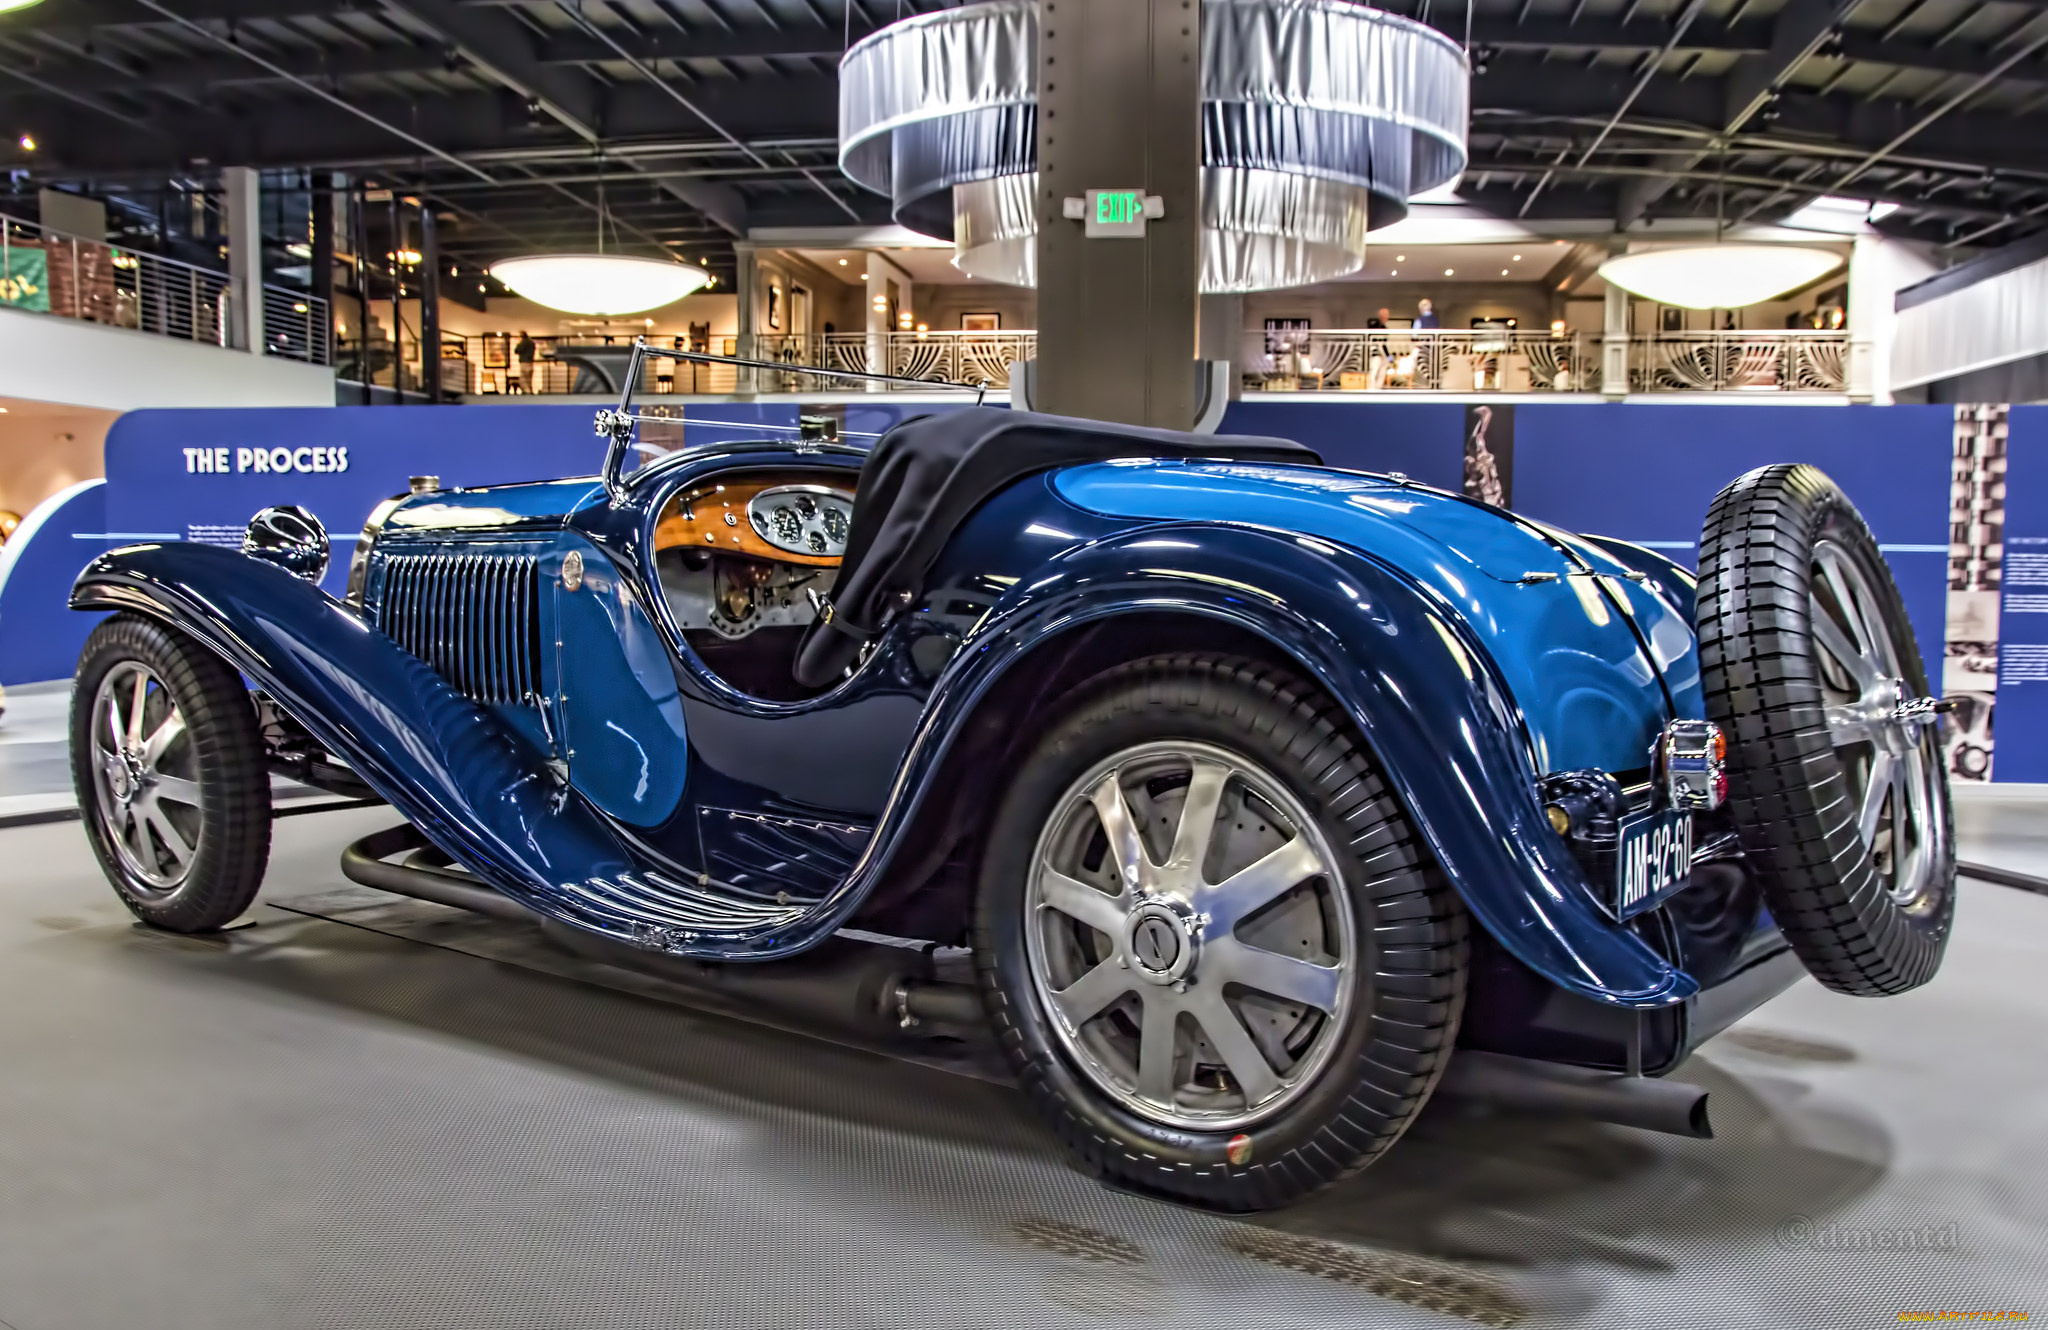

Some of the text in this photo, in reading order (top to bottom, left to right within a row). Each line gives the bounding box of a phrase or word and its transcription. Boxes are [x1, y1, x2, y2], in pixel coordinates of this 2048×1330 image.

[1097, 193, 1135, 223] EXIT
[183, 447, 349, 473] THE PROCESS
[1623, 815, 1692, 907] AM-92-60
